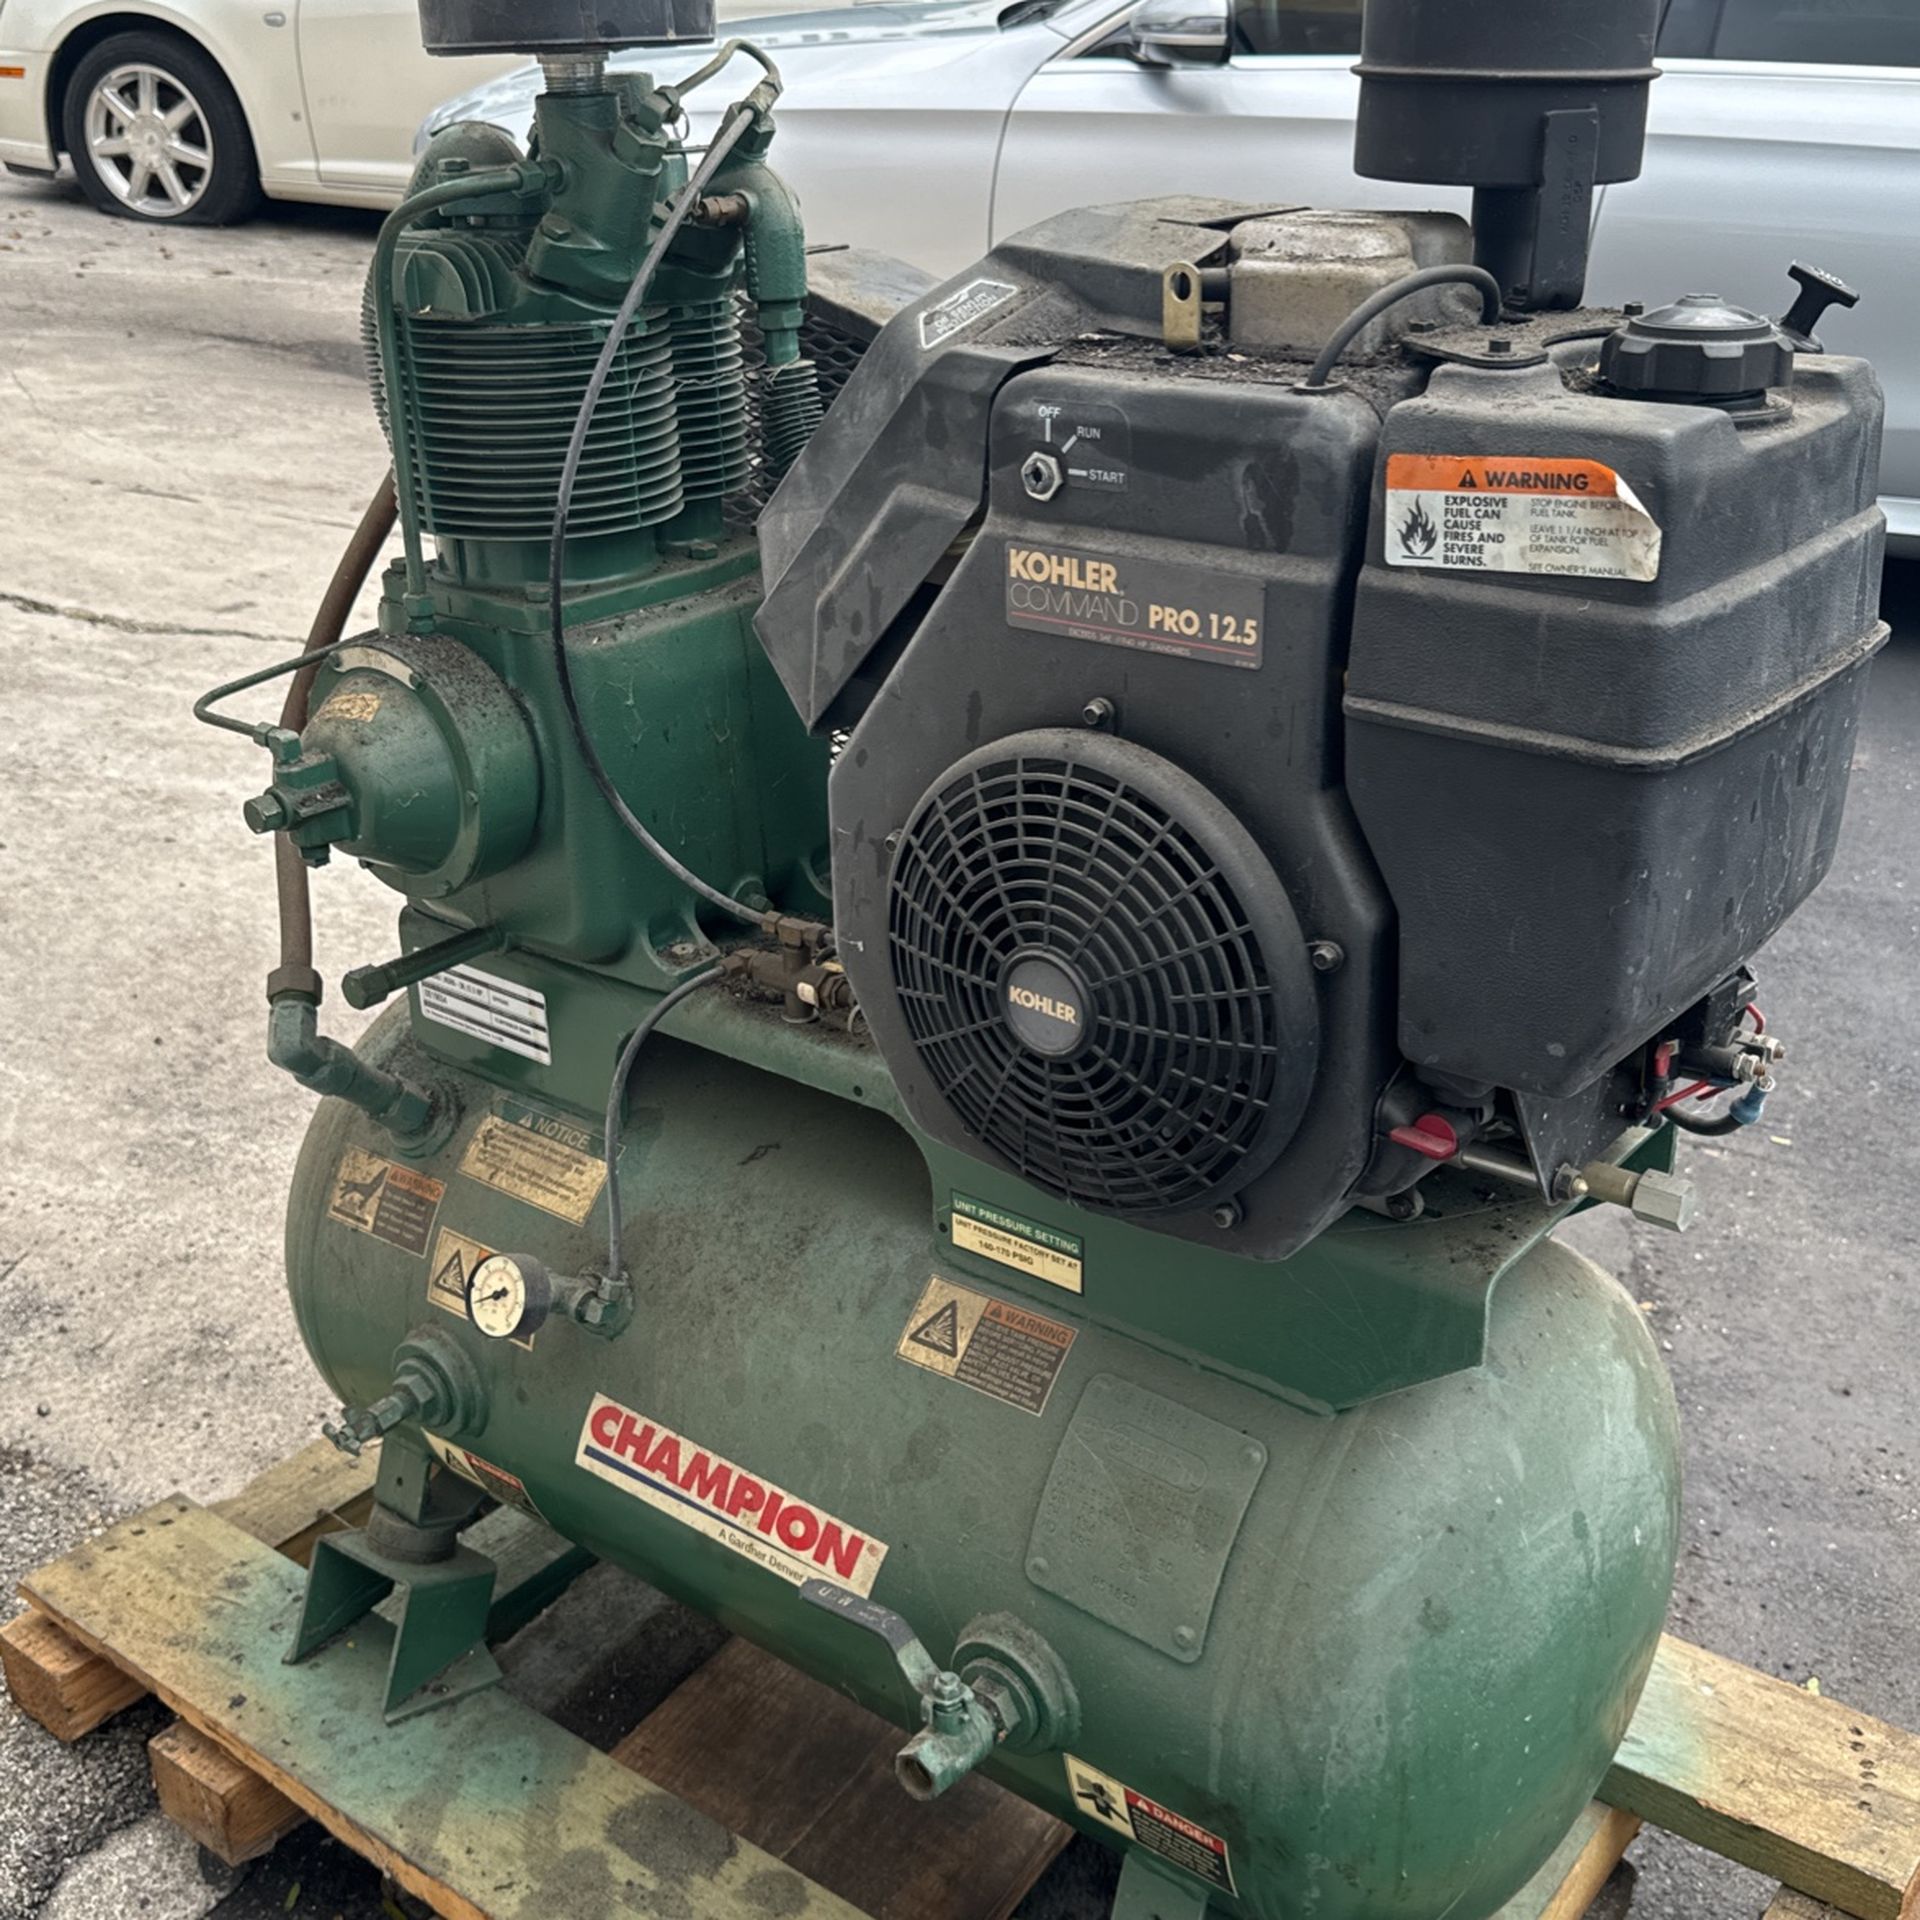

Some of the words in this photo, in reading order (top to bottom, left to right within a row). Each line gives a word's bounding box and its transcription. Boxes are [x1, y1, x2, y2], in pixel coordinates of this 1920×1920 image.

[1038, 406, 1061, 418] OFF
[1077, 426, 1101, 439] RUN
[1089, 469, 1125, 484] START
[1485, 470, 1589, 490] WARNING
[1444, 495, 1508, 508] EXPLOSIVE
[1530, 498, 1552, 507] STOP
[1554, 499, 1587, 509] ENGINE
[1590, 500, 1622, 510] BEFORE
[1444, 508, 1470, 518] FUEL
[1474, 509, 1501, 519] CAN
[1530, 508, 1549, 517] FUEL
[1443, 519, 1481, 531] CAUSE
[1530, 525, 1556, 534] LEAVE
[1584, 527, 1606, 536] INCH
[1609, 528, 1619, 537] AT
[1621, 529, 1638, 538] TOP
[1443, 531, 1473, 542] FIRES
[1477, 533, 1505, 543] AND
[1529, 534, 1542, 543] OF
[1544, 535, 1568, 544] TANK
[1570, 536, 1587, 545] FOR
[1589, 537, 1608, 546] FUEL
[1443, 543, 1484, 554] SEVERE
[1443, 555, 1487, 567] BURNS.
[1009, 548, 1119, 594] KOHLER
[1528, 563, 1543, 572] SEE
[1545, 563, 1587, 574] OWNER'S
[1010, 582, 1139, 626] COMMAND
[1208, 613, 1258, 646] 12.5
[1009, 985, 1076, 1024] KOHLER
[534, 1117, 592, 1150] NOTICE
[953, 1199, 976, 1216] UNIT
[978, 1208, 1033, 1236] PRESSURE
[1034, 1229, 1080, 1254] SETTING
[955, 1217, 972, 1227] UNIT
[973, 1223, 1013, 1244] PRESSURE
[1013, 1240, 1050, 1259] FACTORY
[1051, 1253, 1066, 1265] SET
[1005, 1310, 1069, 1345] WARNING
[590, 1405, 865, 1579] CHAMPION
[718, 1528, 727, 1540] A
[728, 1533, 767, 1561] Gardner
[769, 1555, 804, 1581] Denver
[1153, 1806, 1215, 1848] DANGER
